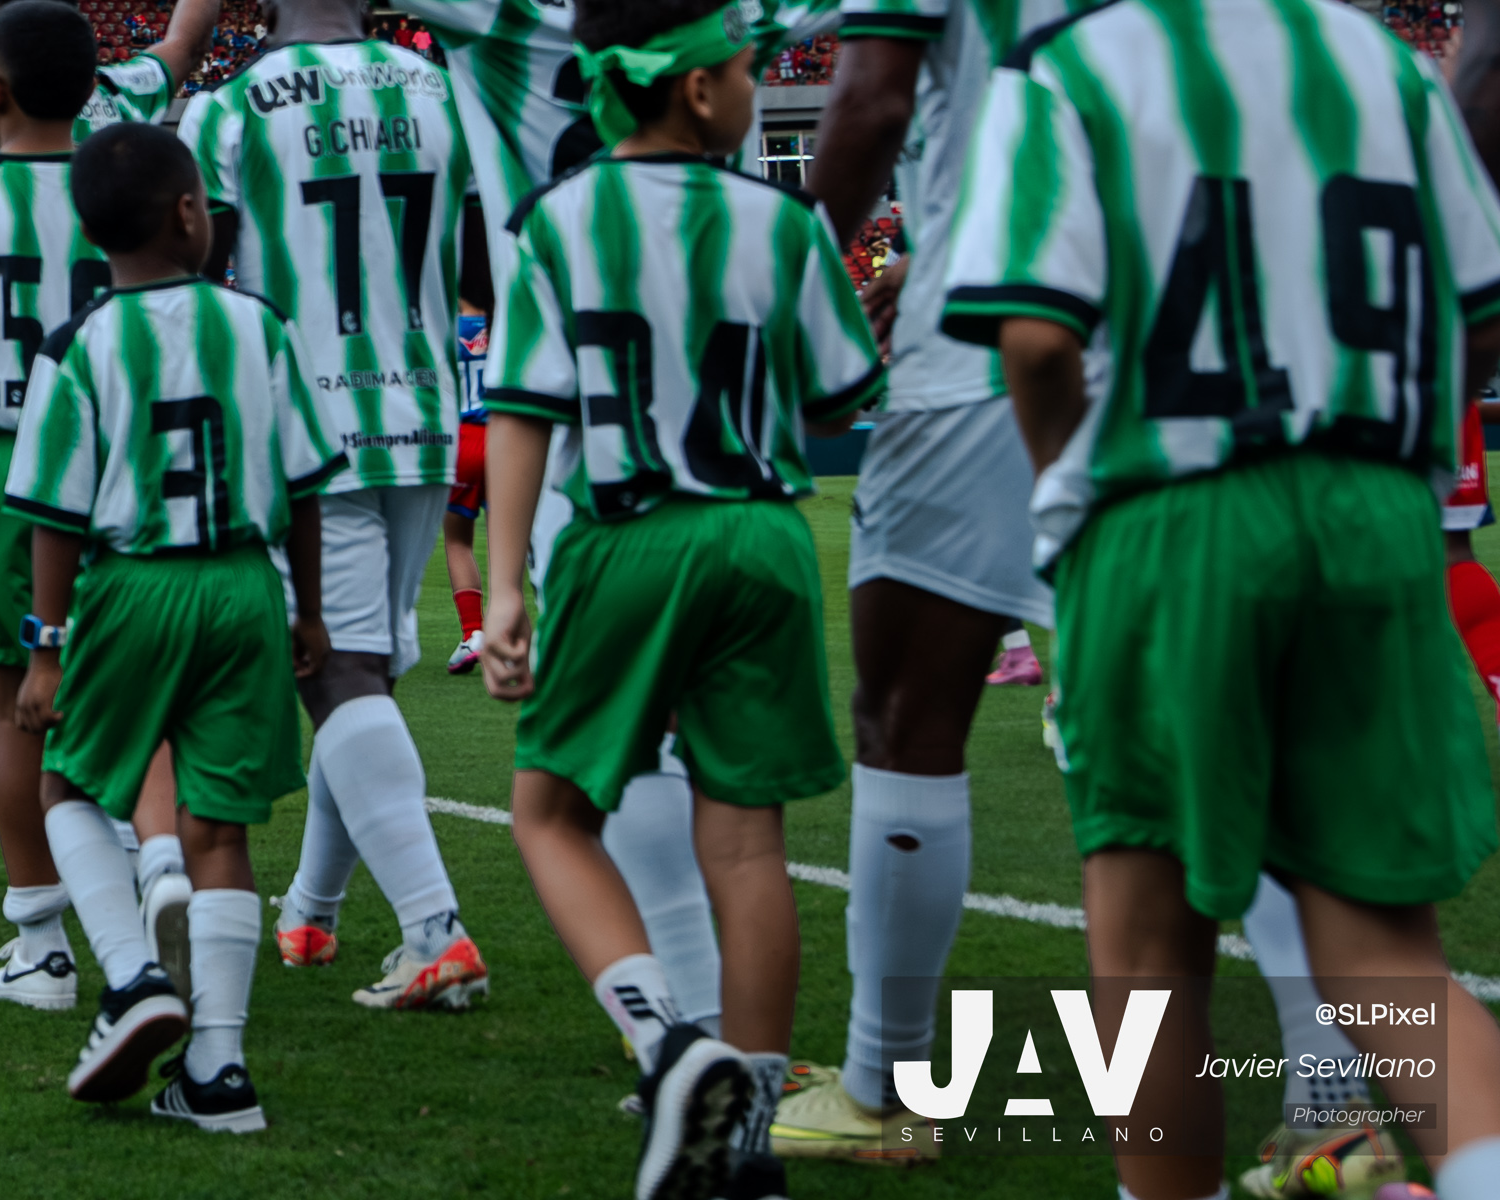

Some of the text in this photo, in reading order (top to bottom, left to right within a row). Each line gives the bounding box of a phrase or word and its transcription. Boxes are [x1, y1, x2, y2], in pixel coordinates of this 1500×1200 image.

[300, 171, 437, 336] 17
[1143, 172, 1438, 468] 49
[151, 395, 230, 558] 3
